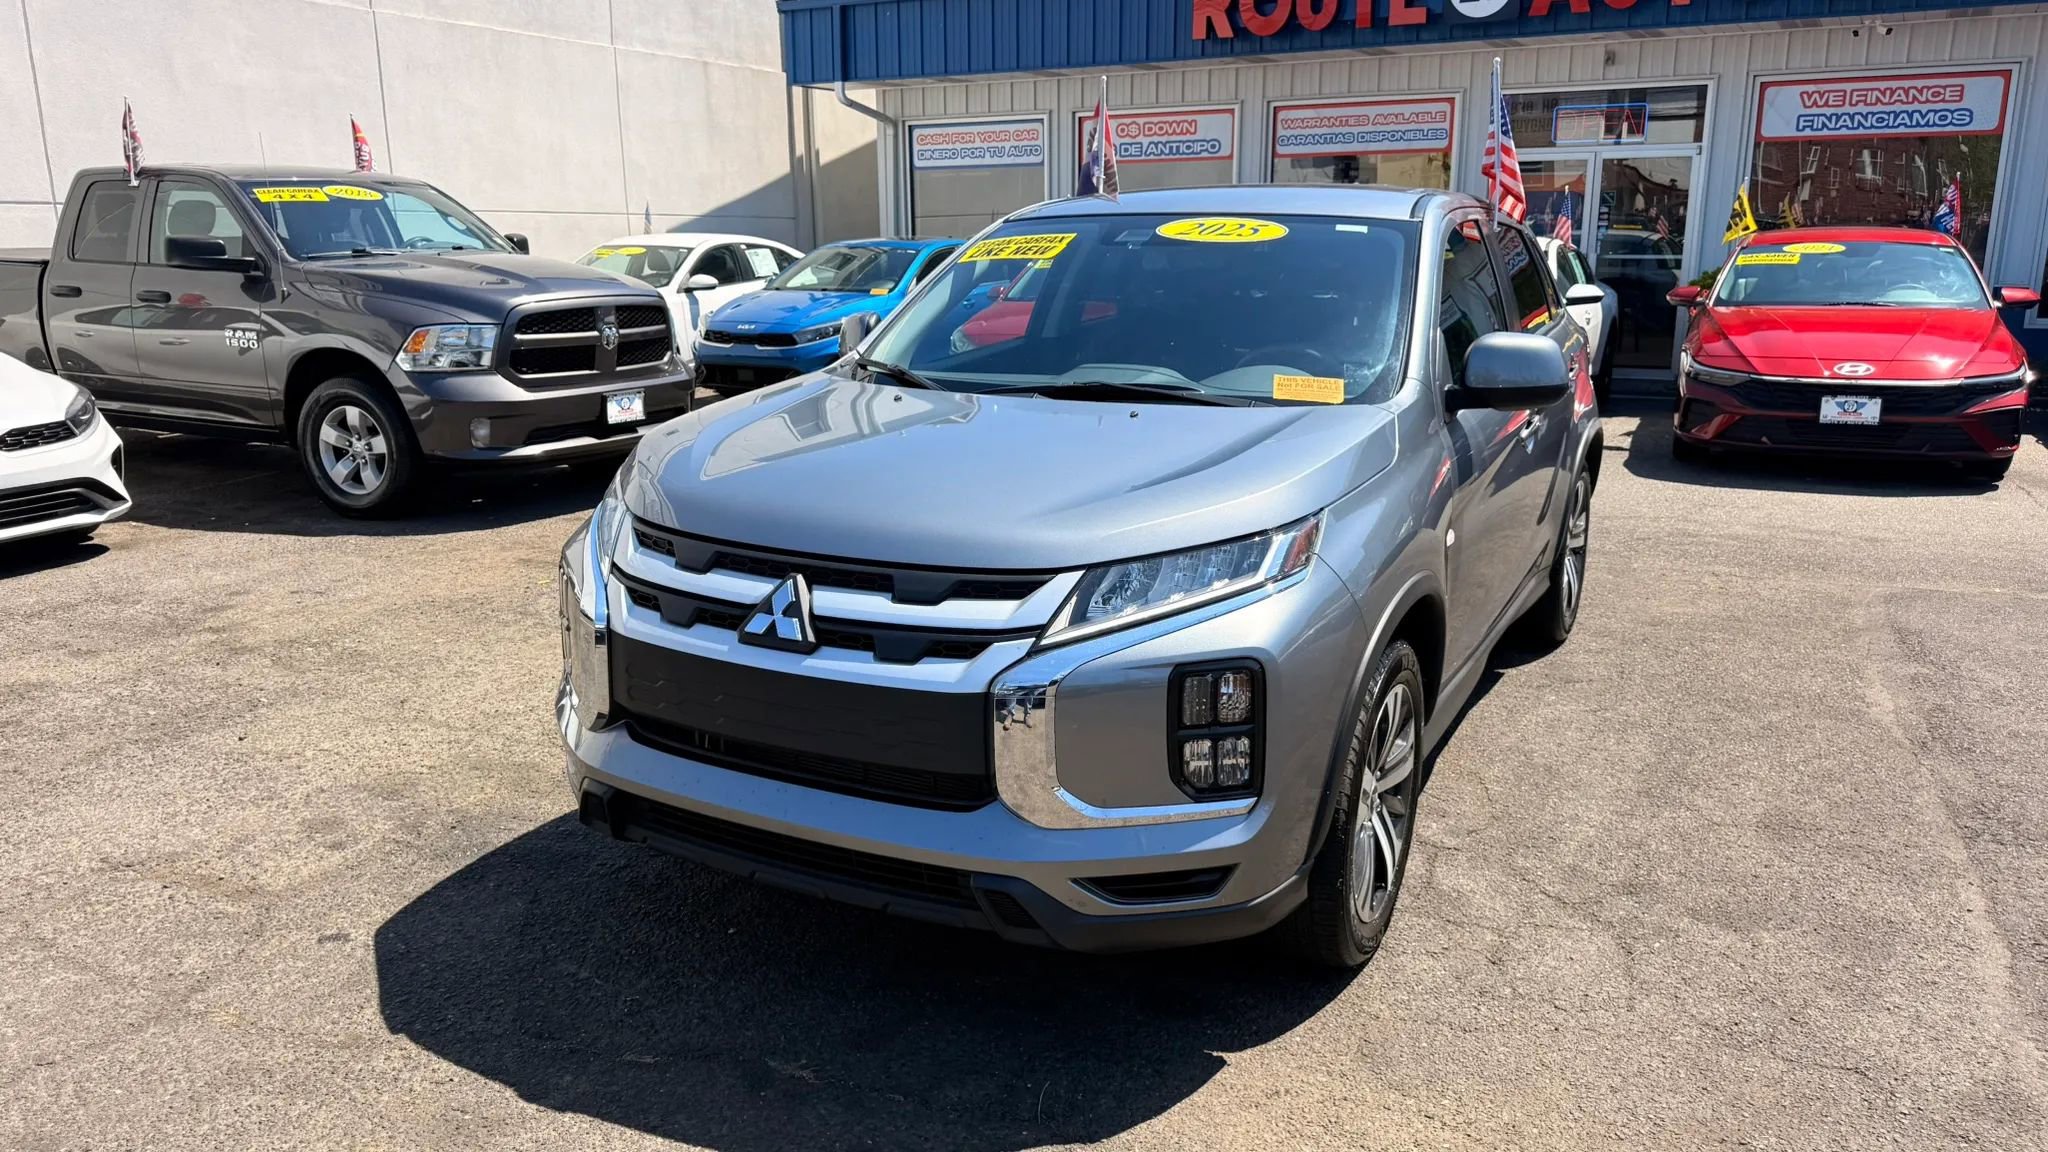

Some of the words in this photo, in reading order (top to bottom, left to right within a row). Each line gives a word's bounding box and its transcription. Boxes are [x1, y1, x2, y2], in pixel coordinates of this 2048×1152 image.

[1800, 90, 1846, 108] WE
[1850, 85, 1964, 105] FINANCE
[1143, 119, 1197, 137] DOWN
[1281, 115, 1369, 130] WARRANTIES
[1372, 111, 1447, 126] AVAILABLE
[1797, 108, 1973, 131] FINANCIAMOS
[917, 133, 949, 146] CASH
[951, 132, 975, 144] FOR
[978, 130, 1010, 143] YOUR
[1013, 129, 1039, 141] CAR
[1278, 132, 1354, 146] GARANTIAS
[1356, 129, 1448, 143] DISPONIBLES
[918, 148, 958, 160] DINERO
[961, 147, 985, 159] POR
[987, 146, 1005, 158] TU
[1007, 145, 1042, 157] AUTO
[1120, 142, 1142, 157] DE
[1145, 139, 1221, 157] ANTICIPO
[1174, 223, 1269, 237] 2025
[967, 246, 1010, 258] LIKE
[1008, 245, 1059, 256] NEW
[224, 329, 257, 339] RAM
[225, 338, 258, 348] 1500
[1300, 377, 1340, 385] VEHICLE
